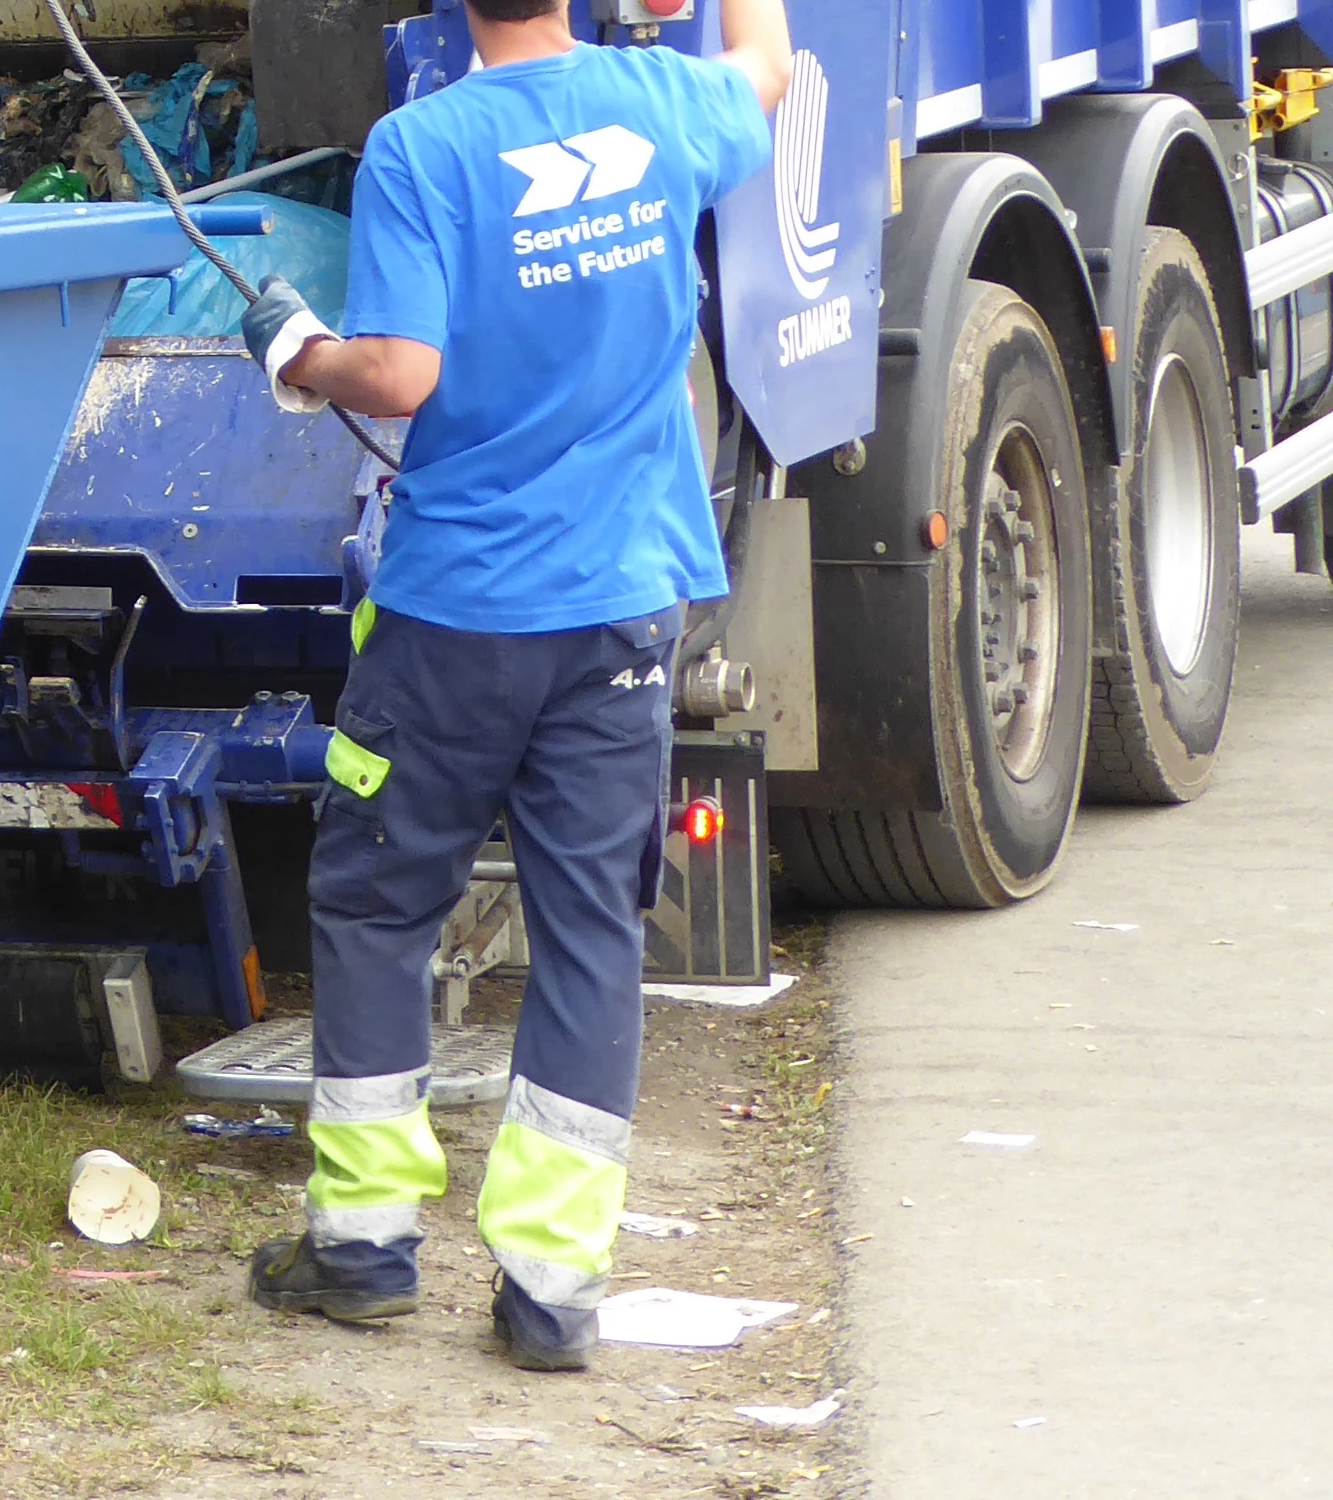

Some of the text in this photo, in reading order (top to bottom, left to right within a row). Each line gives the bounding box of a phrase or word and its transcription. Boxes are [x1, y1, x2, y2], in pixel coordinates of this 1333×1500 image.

[513, 199, 667, 255] Service for
[518, 235, 666, 289] the Future
[778, 295, 853, 368] STUMMER
